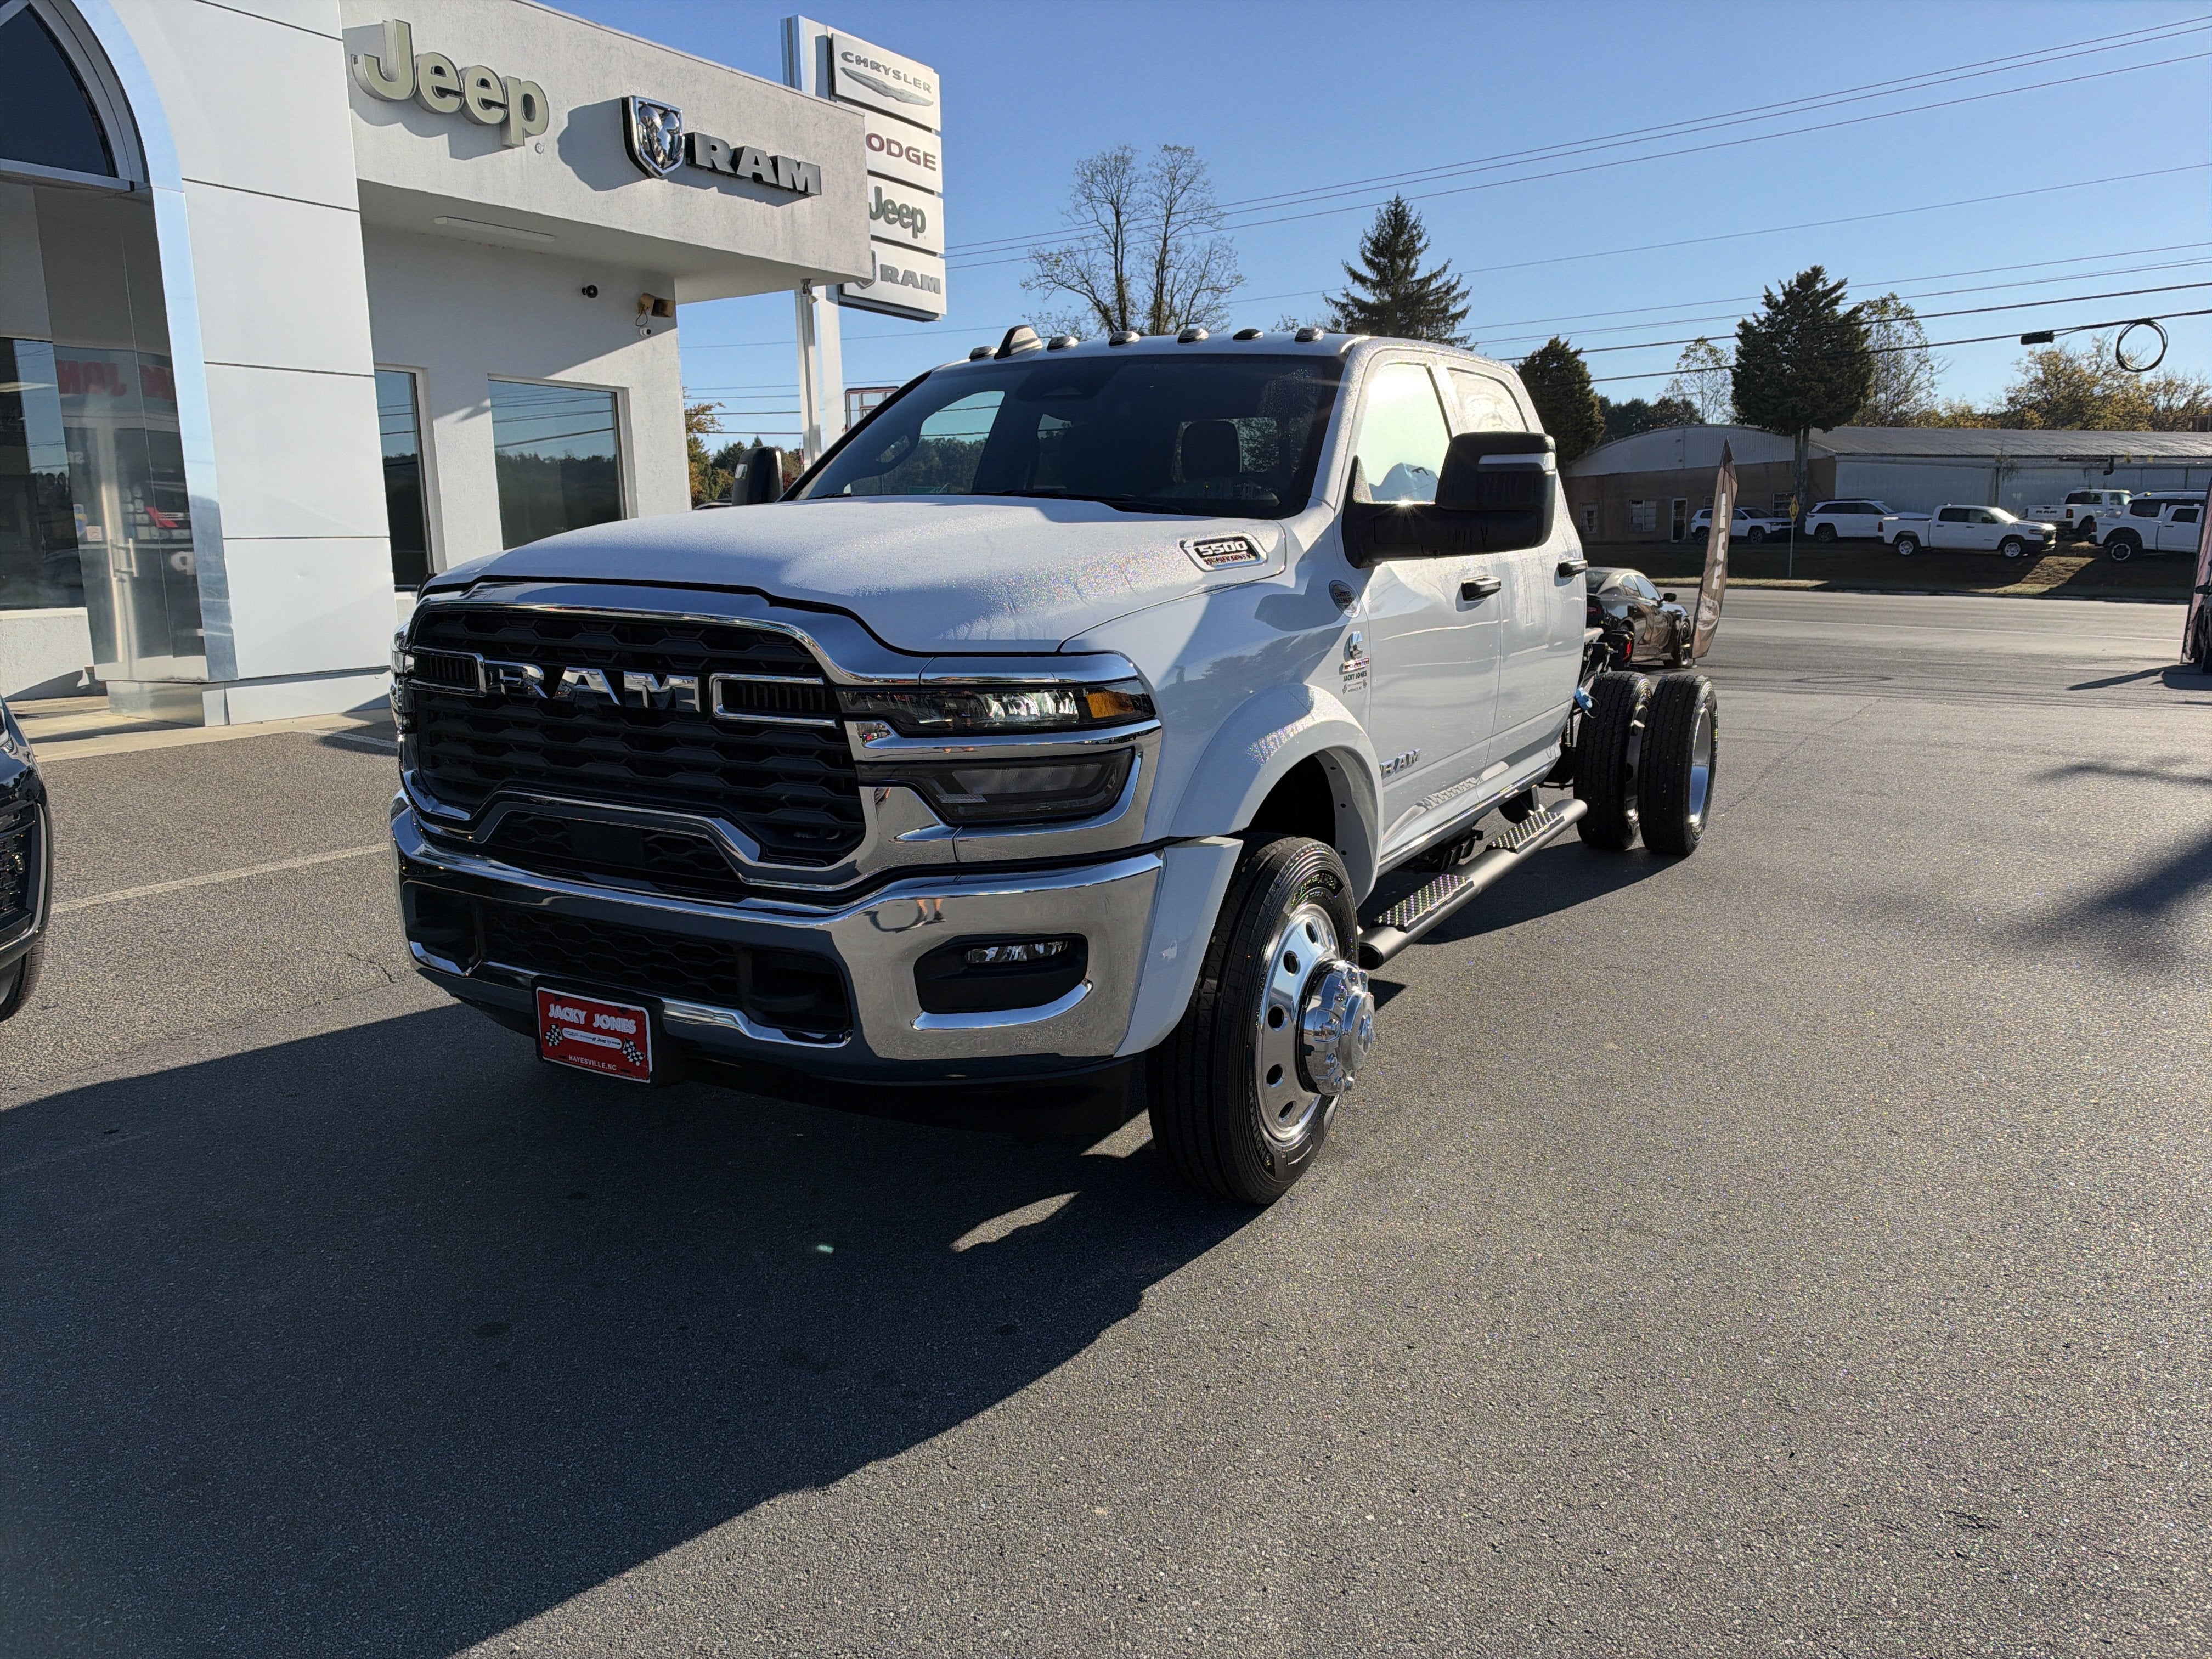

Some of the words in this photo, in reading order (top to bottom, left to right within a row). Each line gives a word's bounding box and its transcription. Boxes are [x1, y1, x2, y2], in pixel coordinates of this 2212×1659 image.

[355, 19, 549, 147] Jeep
[841, 52, 932, 93] CHRYSLER
[686, 132, 822, 196] RAM
[866, 133, 936, 171] ODGE
[869, 186, 926, 239] Jeep
[880, 263, 941, 295] RAM
[1199, 540, 1248, 555] 5500
[483, 660, 700, 713] RAM
[1343, 674, 1355, 682] JACKY
[1356, 670, 1367, 679] JONES
[1380, 748, 1421, 777] RAM
[548, 1004, 587, 1024] JACKY
[592, 1014, 636, 1034] JONES
